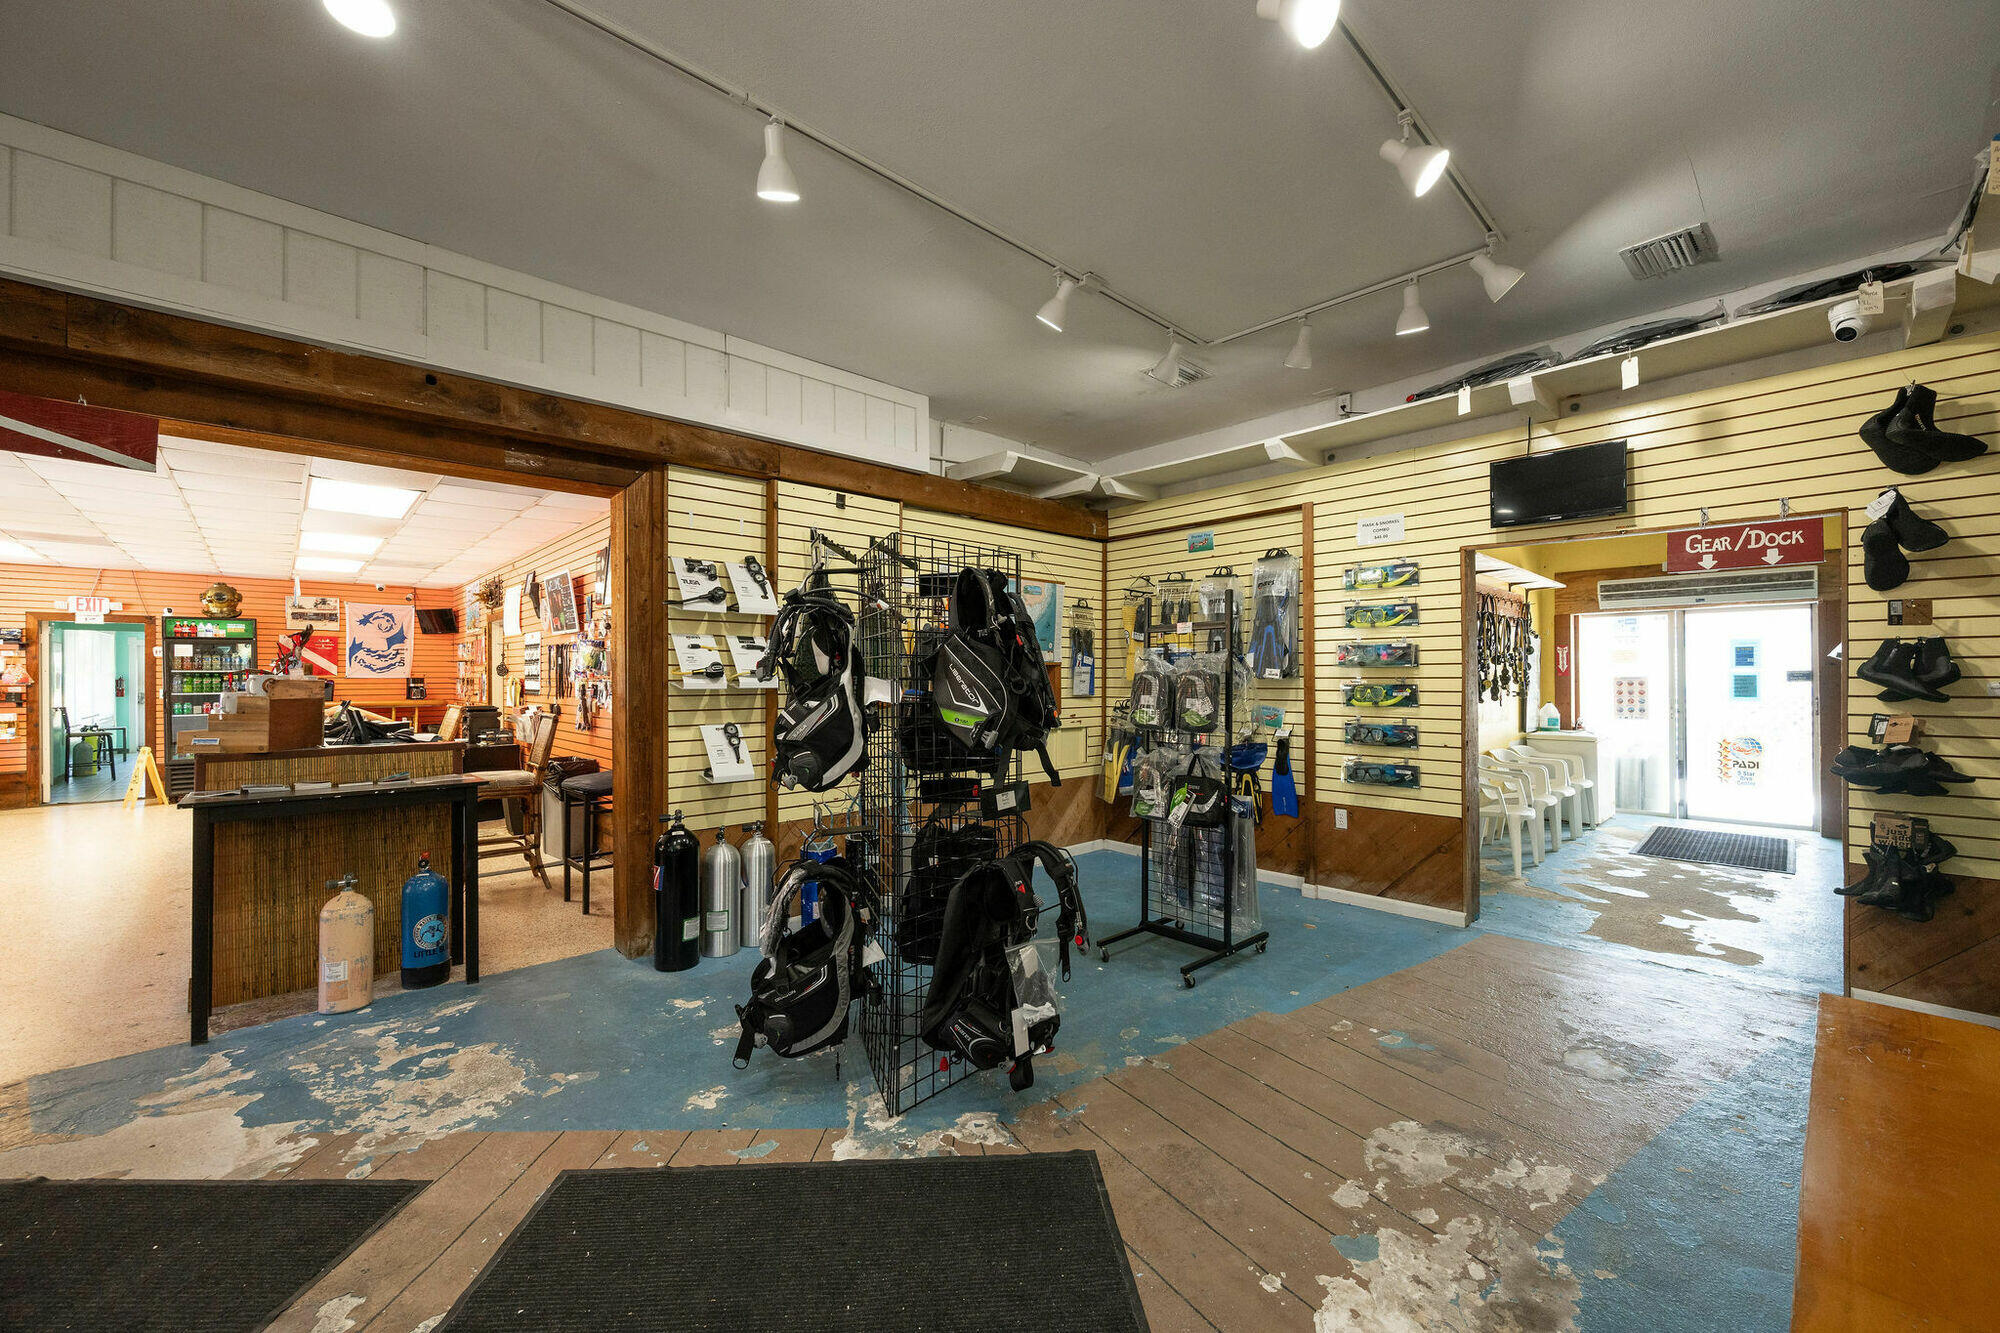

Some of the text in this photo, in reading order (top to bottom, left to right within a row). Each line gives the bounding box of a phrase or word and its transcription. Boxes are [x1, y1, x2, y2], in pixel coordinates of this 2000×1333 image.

[75, 597, 105, 613] EXIT
[1732, 760, 1760, 769] PADI
[1886, 828, 1908, 836] just
[414, 947, 438, 959] LITTLE
